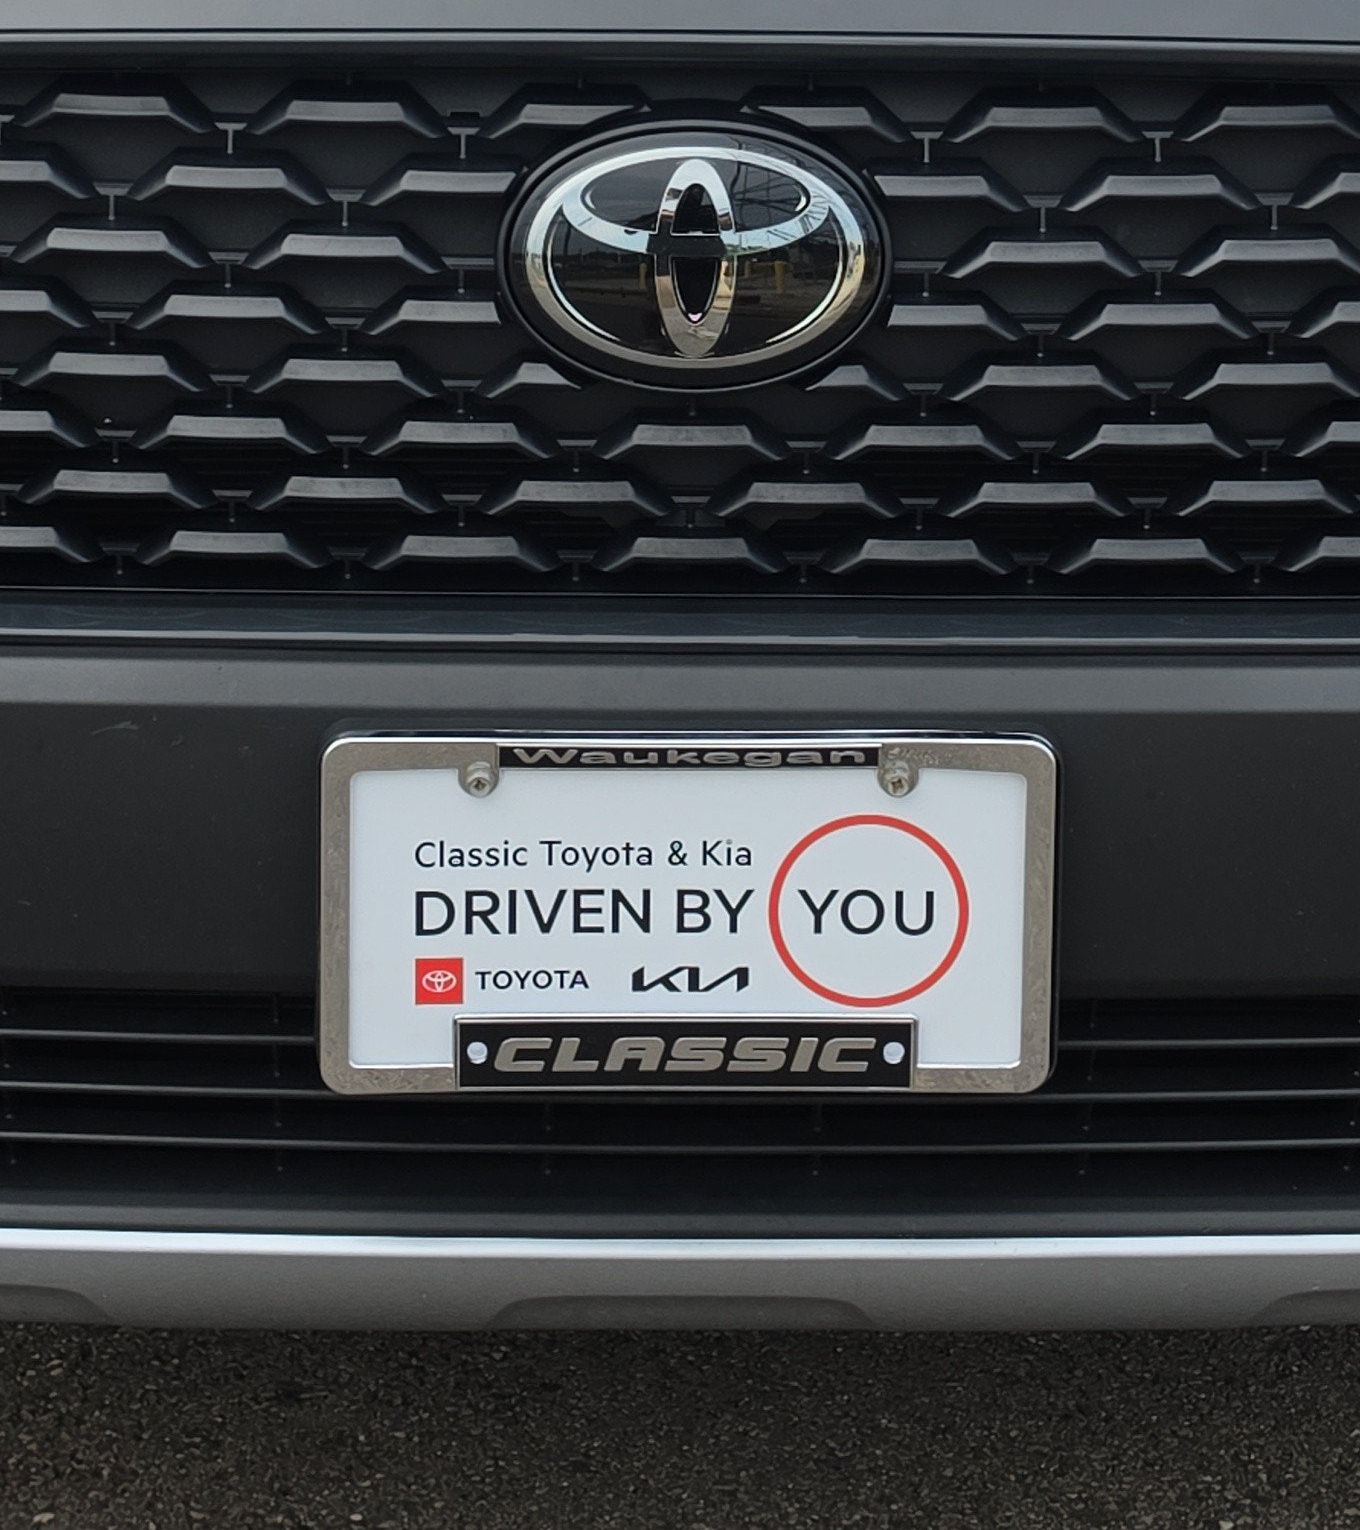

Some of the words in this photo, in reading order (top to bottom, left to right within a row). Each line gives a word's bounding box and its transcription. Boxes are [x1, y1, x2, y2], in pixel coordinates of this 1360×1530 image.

[512, 748, 867, 768] Waukegan
[413, 839, 529, 868] Classic
[538, 839, 653, 873] Toyota
[666, 839, 689, 868] &
[701, 839, 753, 868] Kia
[414, 888, 652, 937] DRIVEN
[675, 888, 756, 935] BY
[796, 888, 936, 937] YOU
[473, 968, 591, 991] TOYOTA
[492, 1035, 879, 1073] CLASSIC
